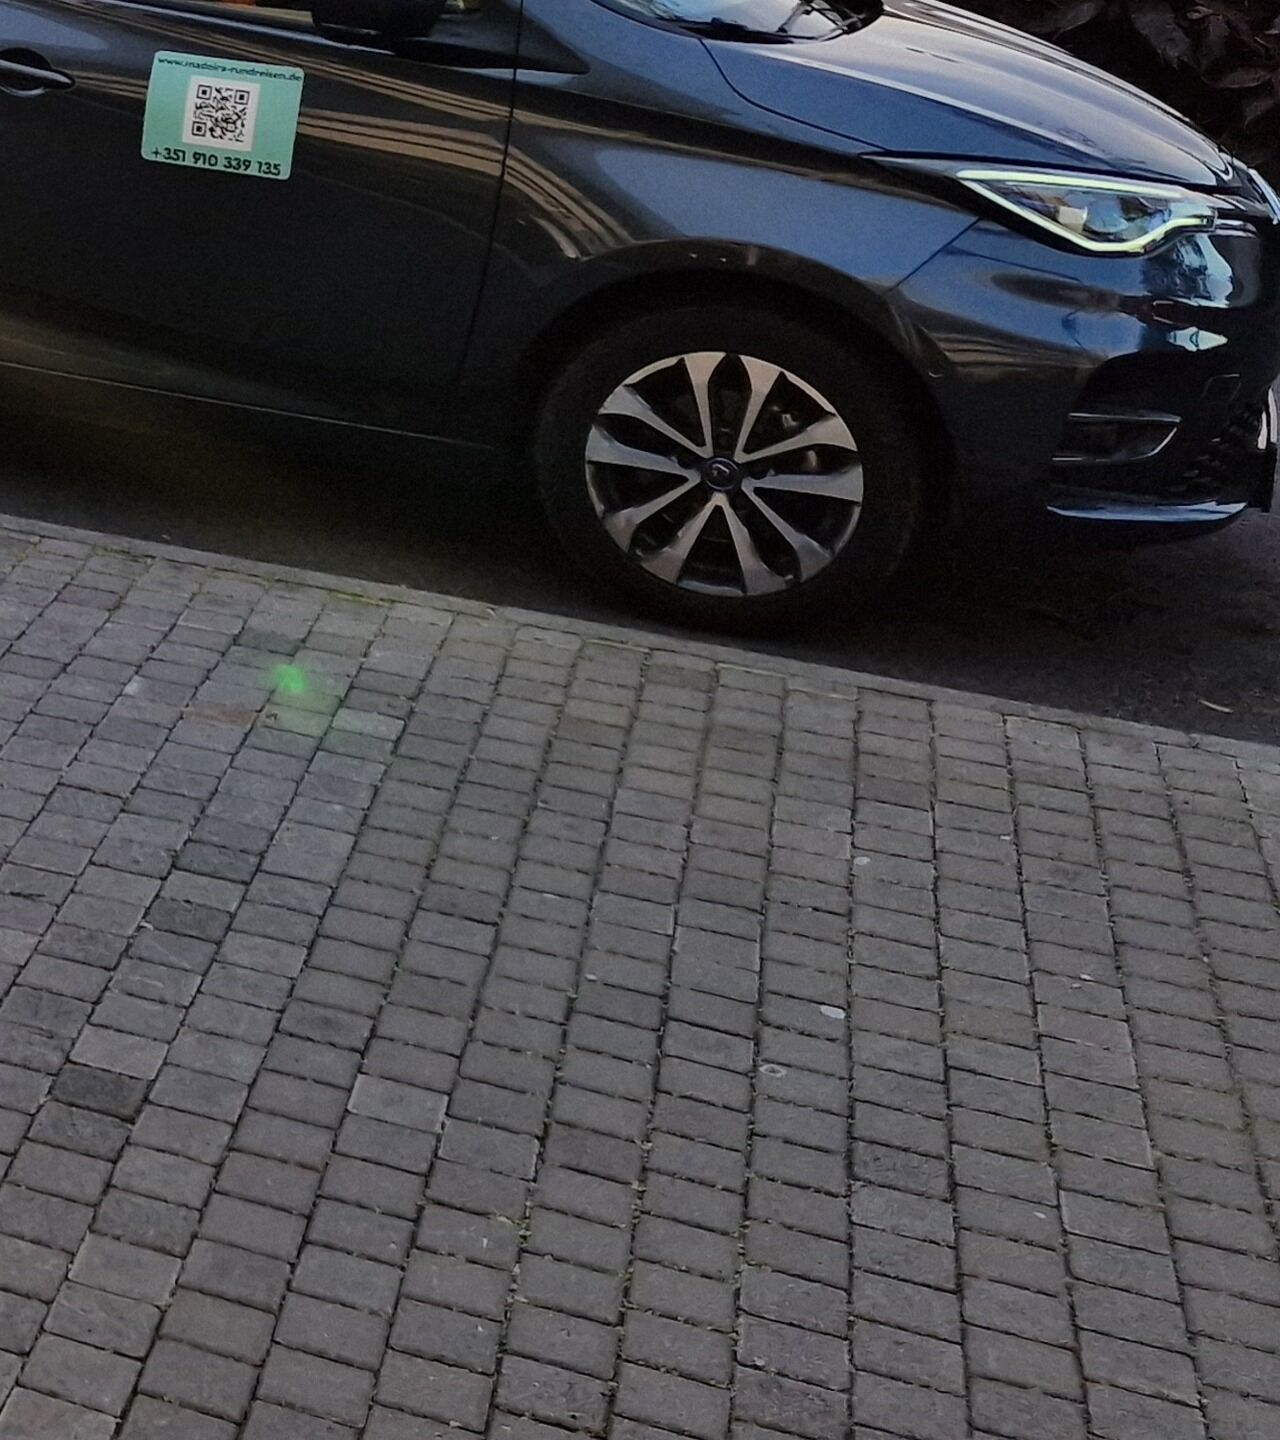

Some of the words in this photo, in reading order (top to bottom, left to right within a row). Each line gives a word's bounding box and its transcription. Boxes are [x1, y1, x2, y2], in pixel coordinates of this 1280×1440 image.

[152, 148, 186, 162] +351
[192, 151, 218, 167] 910
[223, 156, 251, 172] 339
[257, 160, 281, 176] 135
